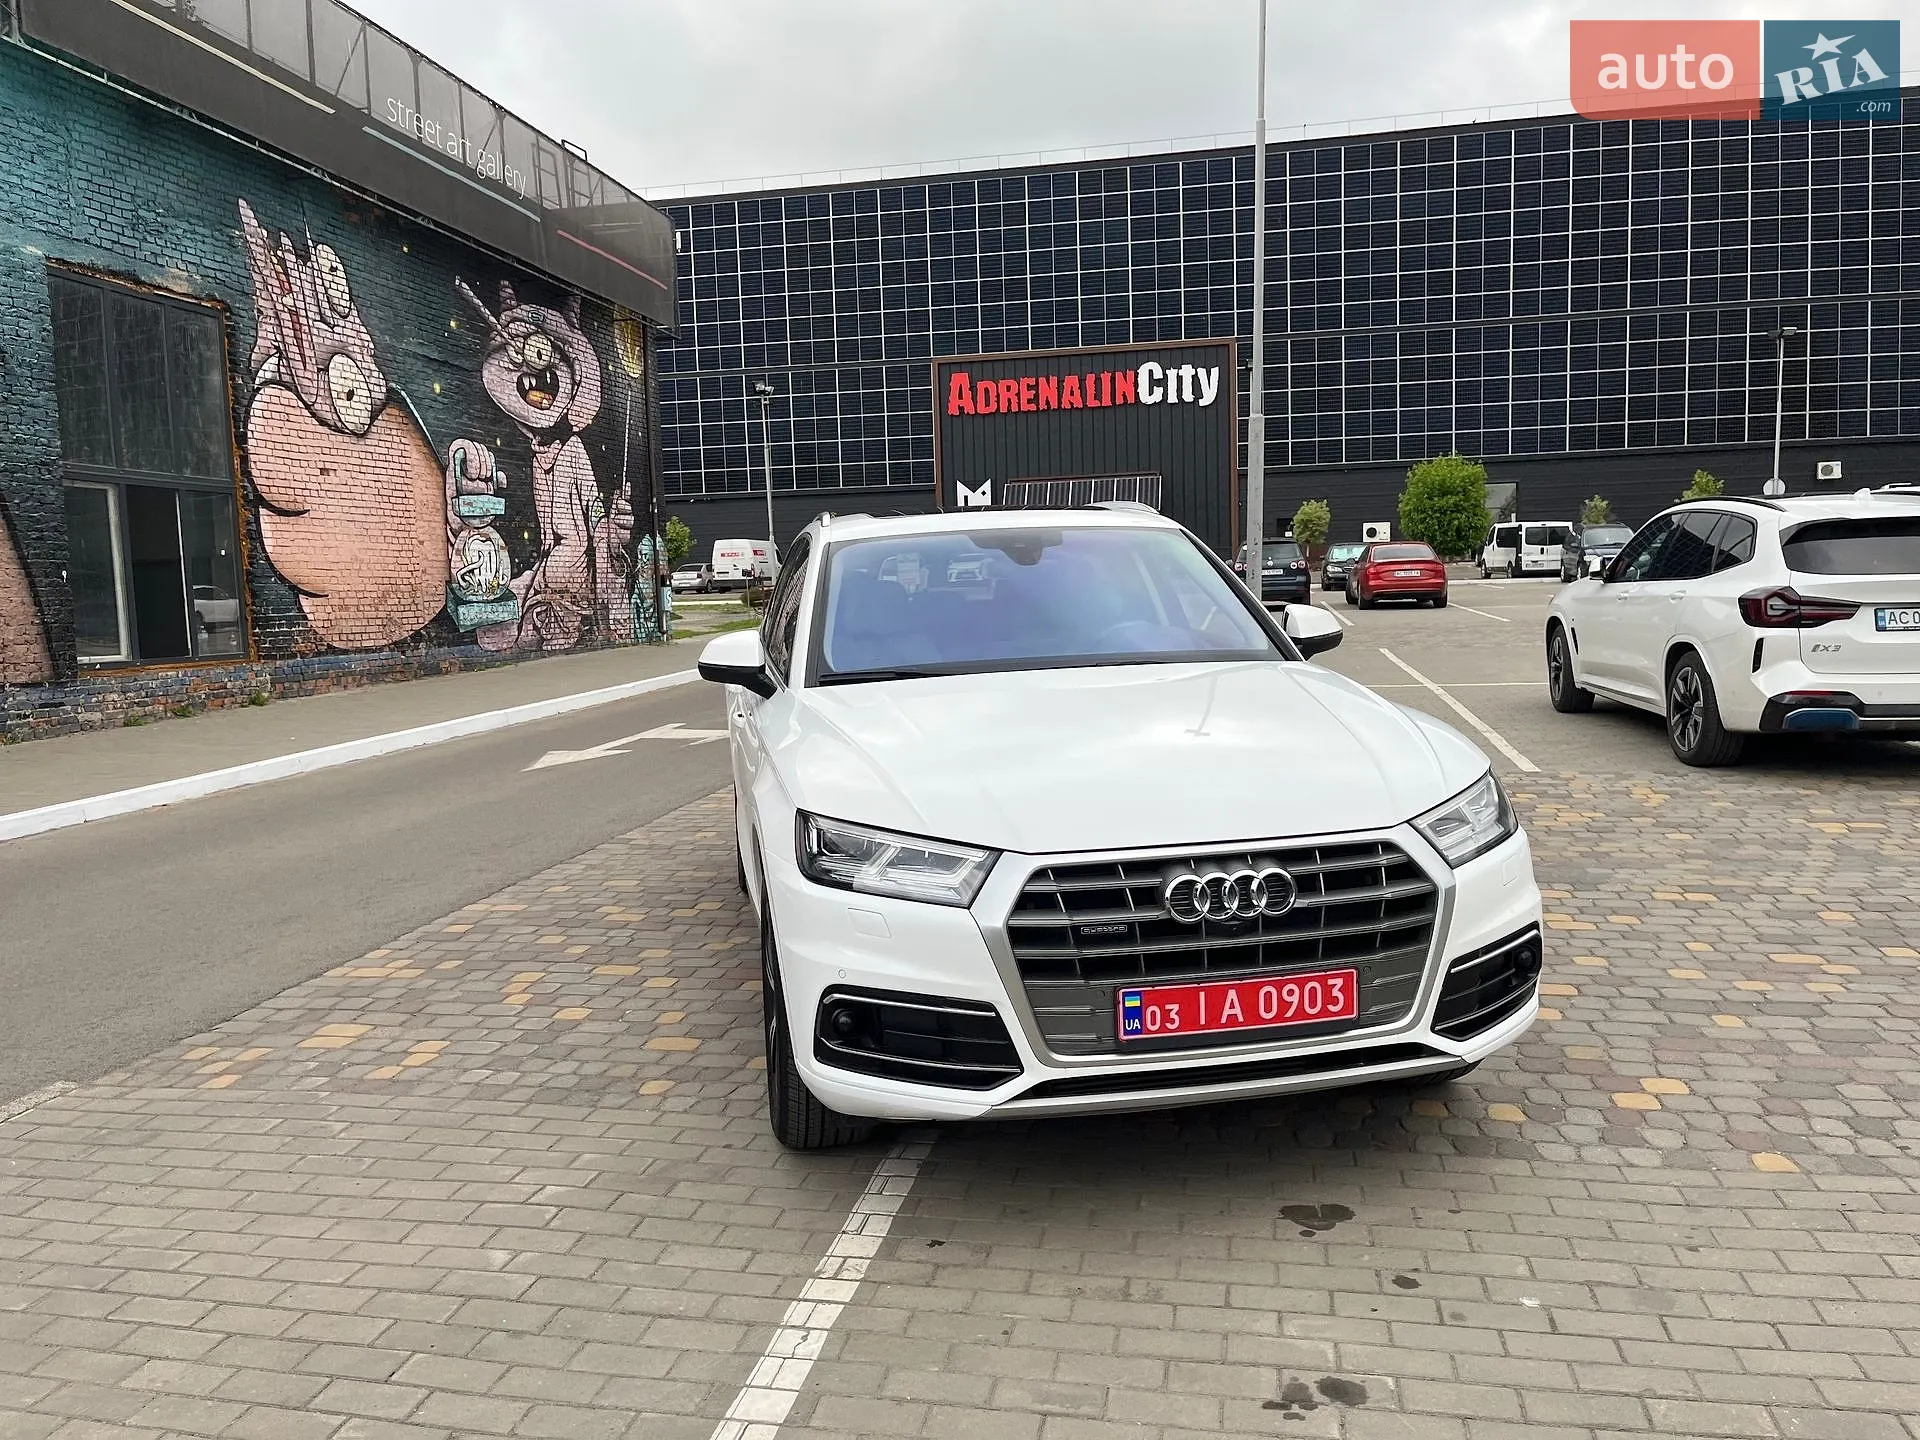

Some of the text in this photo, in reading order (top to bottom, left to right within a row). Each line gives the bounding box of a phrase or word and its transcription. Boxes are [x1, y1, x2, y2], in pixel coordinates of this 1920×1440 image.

[387, 98, 527, 200] street art gallery
[1888, 611, 1909, 625] AC
[1145, 1003, 1180, 1032] 03
[1258, 977, 1345, 1020] 0903
[1125, 1018, 1141, 1031] UA
